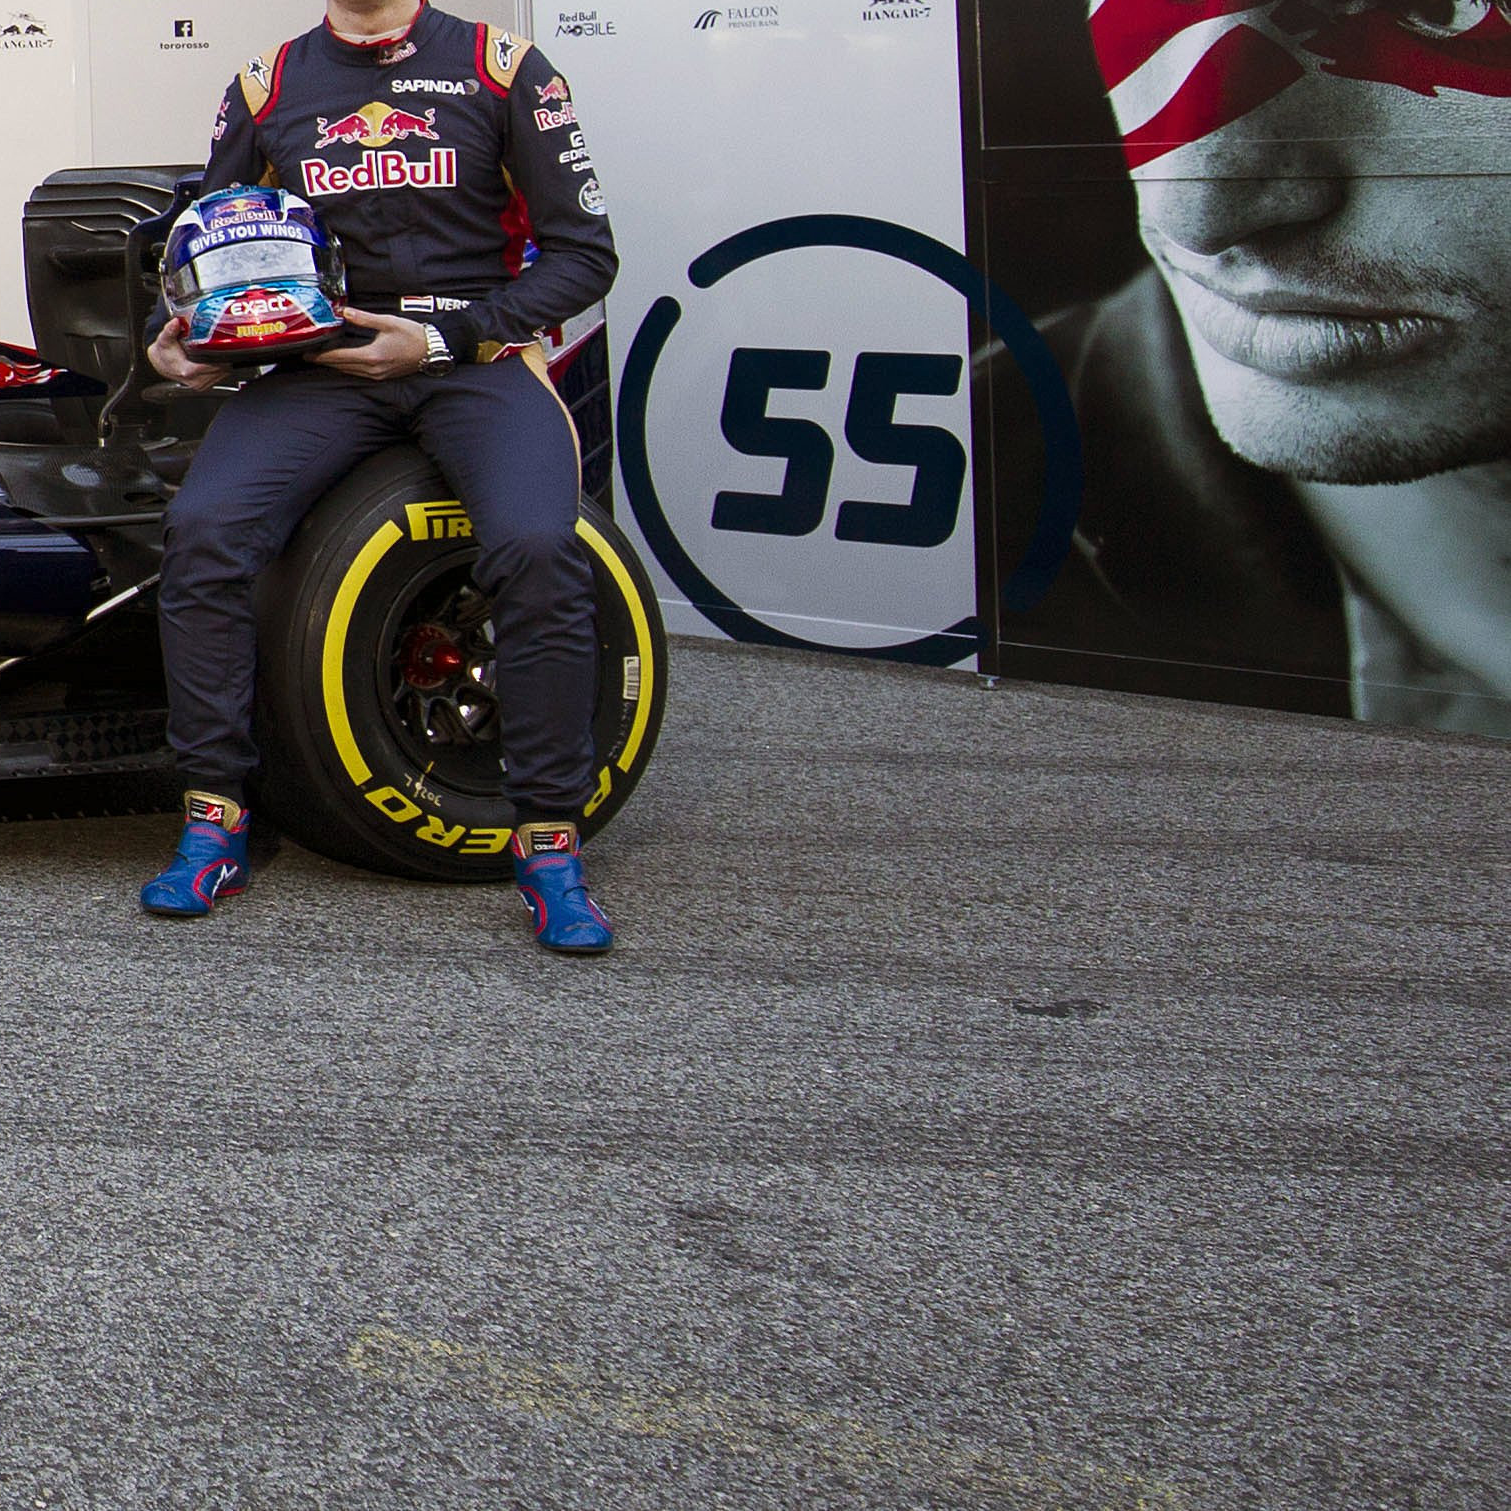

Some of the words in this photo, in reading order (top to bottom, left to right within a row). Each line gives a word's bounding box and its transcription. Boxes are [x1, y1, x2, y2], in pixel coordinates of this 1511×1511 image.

[728, 5, 778, 19] FALCON
[160, 41, 210, 50] tororosso
[391, 79, 466, 95] SAPINDA
[533, 102, 569, 132] Red
[300, 153, 377, 199] Red
[377, 147, 458, 190] Bull
[242, 210, 278, 223] Bull
[191, 230, 226, 252] GIVES
[228, 225, 257, 240] YOU
[259, 225, 303, 239] WINGS
[711, 347, 967, 548] 55
[364, 785, 513, 855] ERO
